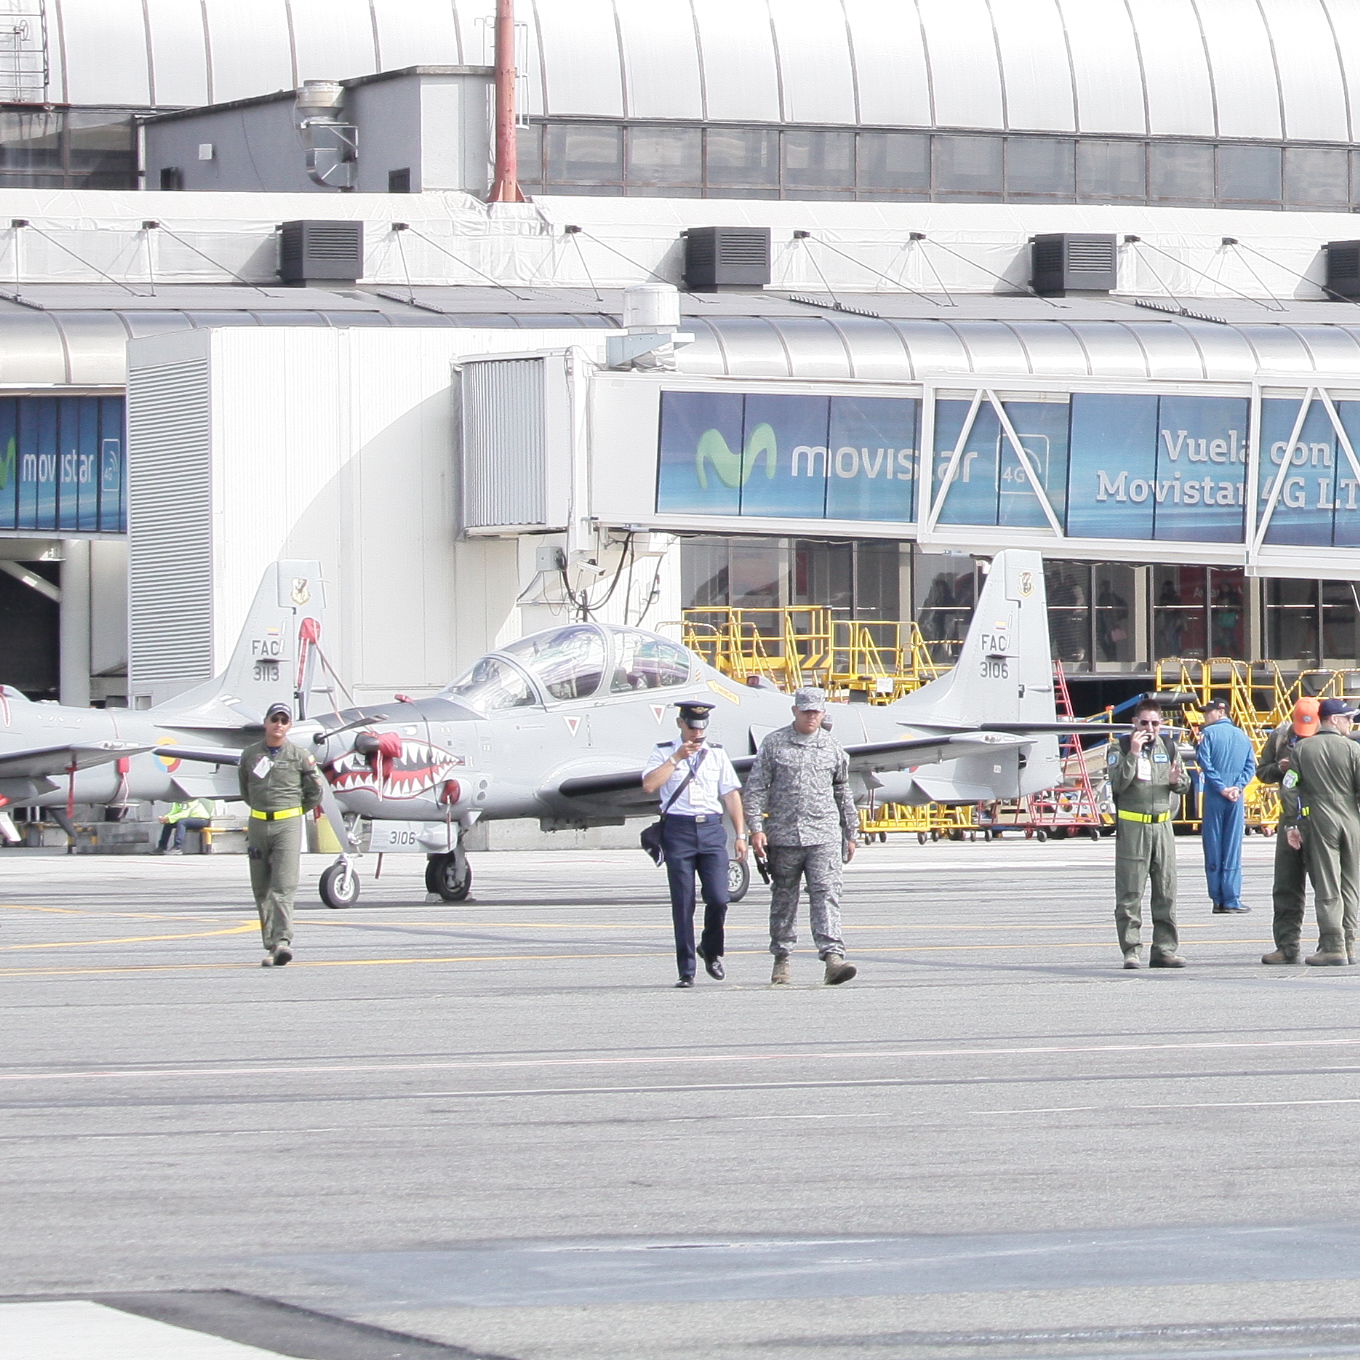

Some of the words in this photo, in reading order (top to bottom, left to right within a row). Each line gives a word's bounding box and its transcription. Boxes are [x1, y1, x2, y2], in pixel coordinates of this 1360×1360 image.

[1270, 441, 1332, 467] con
[23, 449, 95, 483] movistar
[791, 445, 978, 483] movisar
[1003, 466, 1026, 483] 4G
[1261, 476, 1306, 509] 4G
[252, 640, 279, 656] FAC
[982, 634, 1007, 651] FAC
[252, 666, 280, 682] 3113
[979, 661, 1009, 679] 3106
[389, 830, 417, 845] 3106
